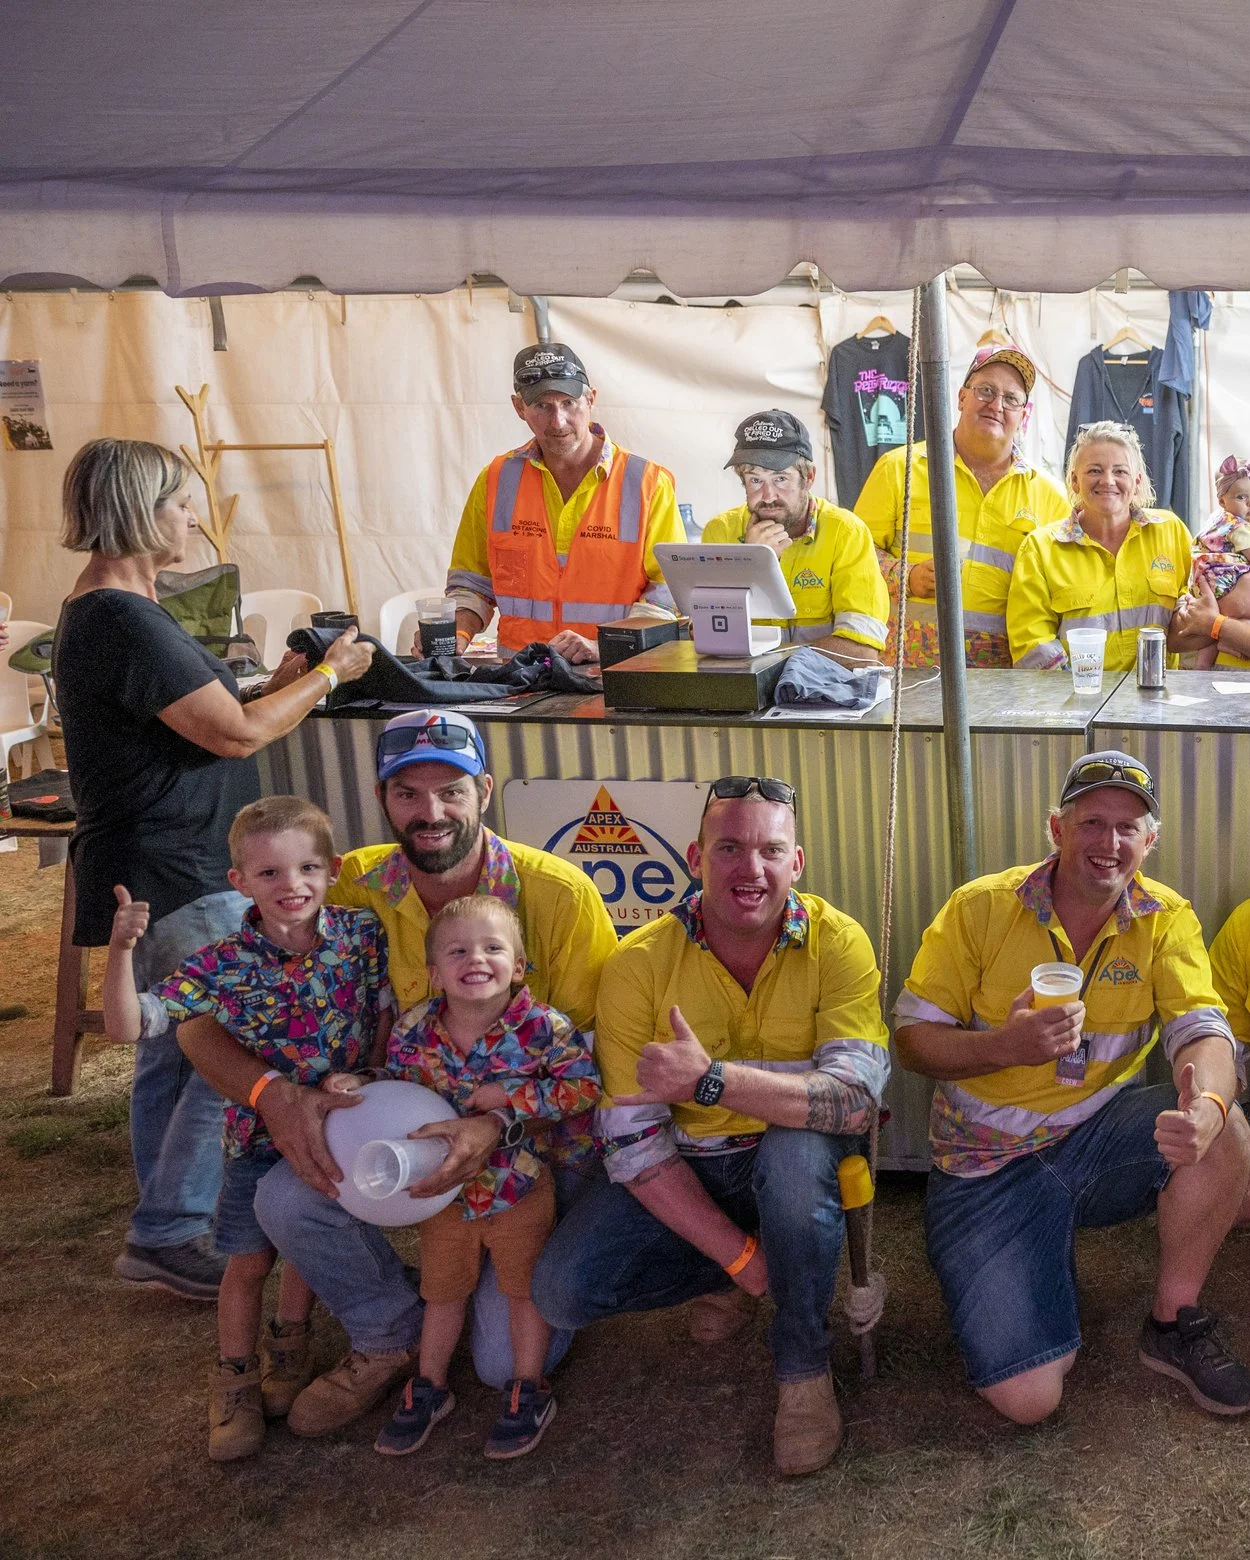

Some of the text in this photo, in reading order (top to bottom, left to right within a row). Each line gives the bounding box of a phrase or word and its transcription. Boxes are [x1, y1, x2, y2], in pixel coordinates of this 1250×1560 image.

[859, 369, 885, 381] THE
[769, 426, 784, 434] OUT
[511, 525, 547, 534] DISTANCING
[580, 532, 616, 540] MARSHAL
[793, 576, 825, 589] Apex
[588, 814, 622, 824] APEX
[574, 844, 642, 854] AUSTRALIA
[1098, 967, 1145, 986] Apex
[1062, 1077, 1078, 1086] CREW
